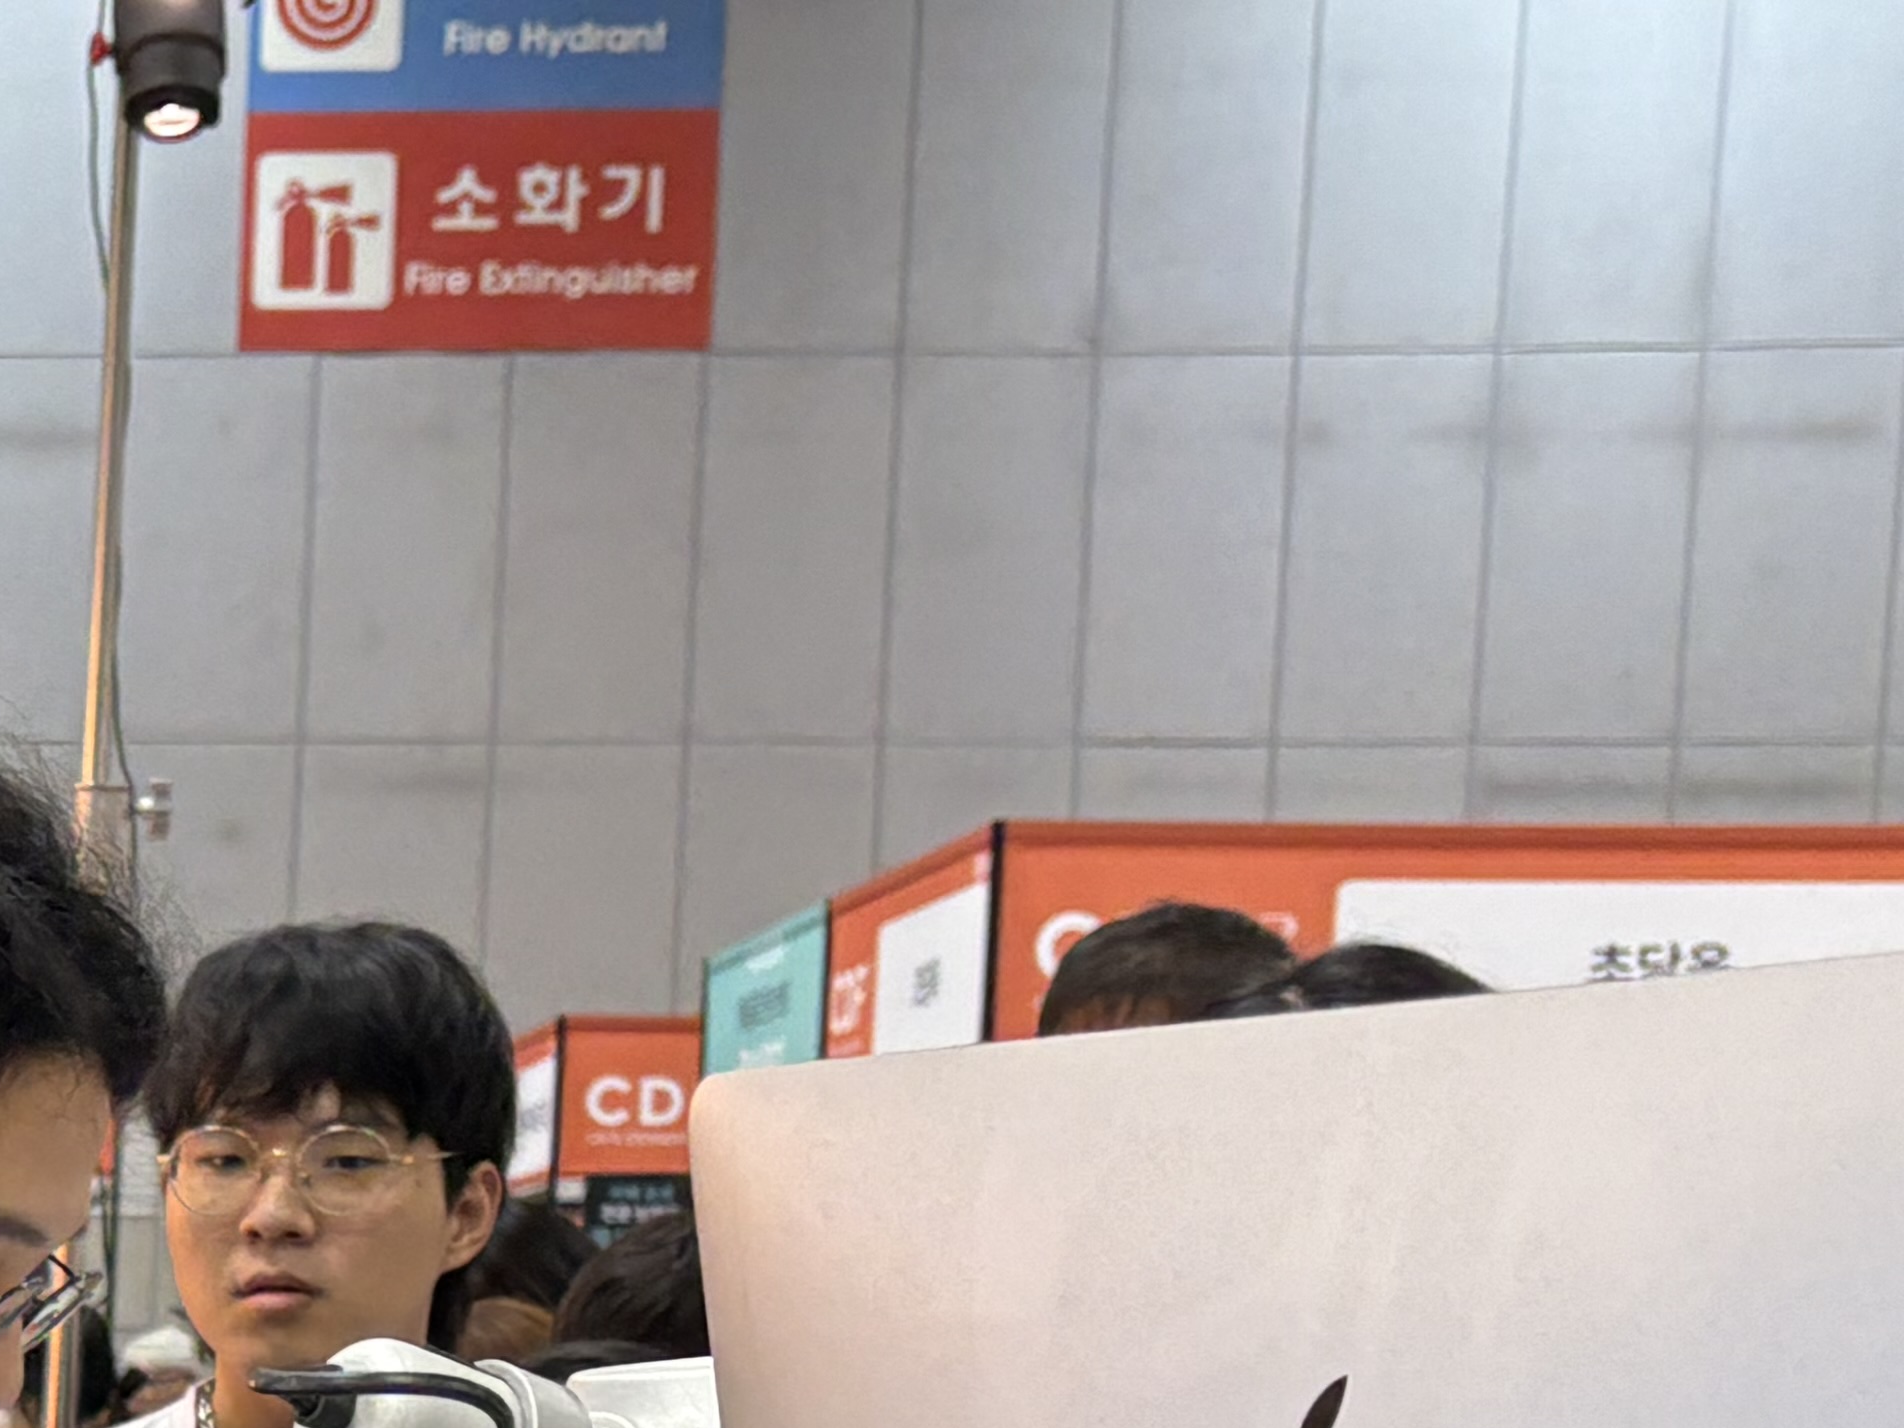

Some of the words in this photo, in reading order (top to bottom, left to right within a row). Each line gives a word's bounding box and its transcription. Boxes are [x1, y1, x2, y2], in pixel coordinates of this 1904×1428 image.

[442, 20, 510, 57] Fire
[518, 19, 667, 58] Hydrant
[404, 261, 471, 297] Fire
[481, 259, 700, 302] Extinguisher
[585, 1074, 686, 1127] CD
